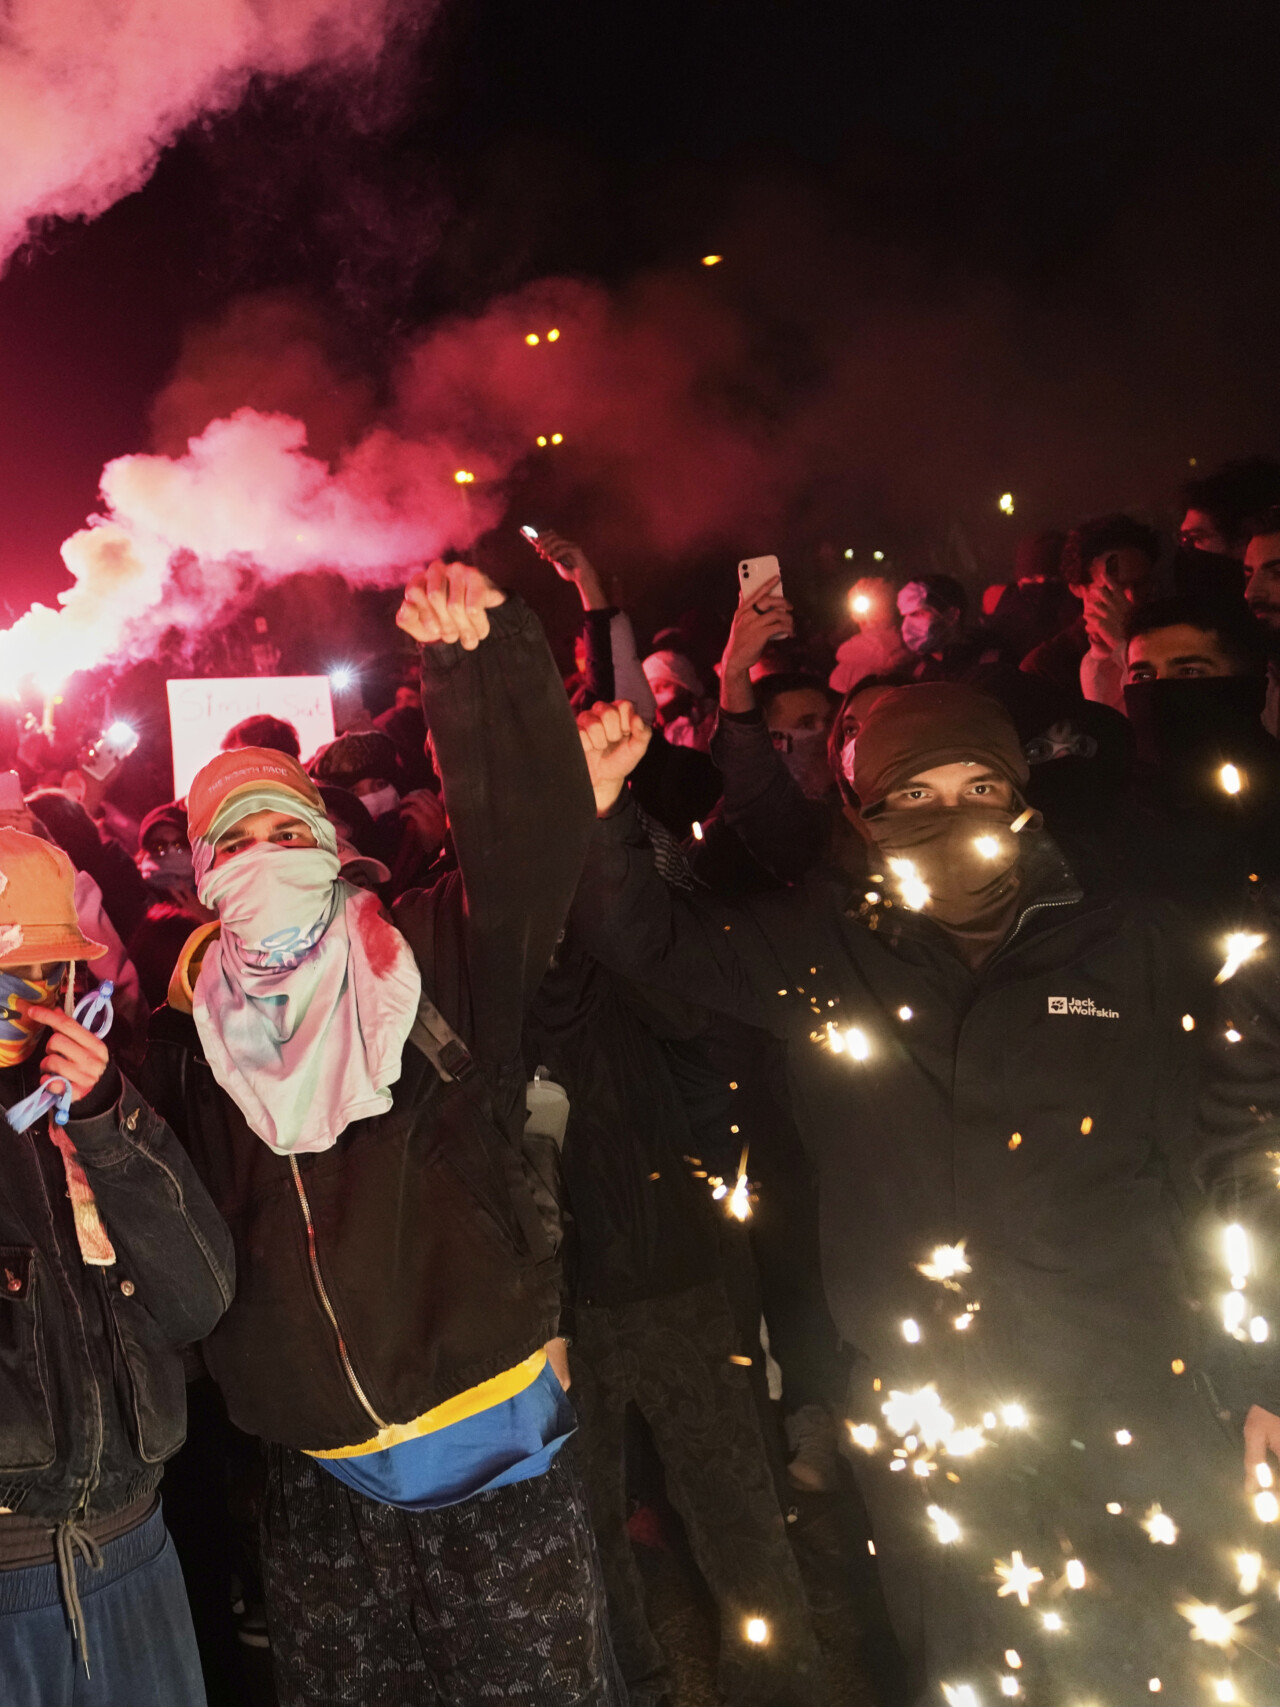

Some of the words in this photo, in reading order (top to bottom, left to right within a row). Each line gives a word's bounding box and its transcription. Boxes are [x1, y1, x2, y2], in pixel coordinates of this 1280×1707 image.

[208, 779, 223, 793] THE
[225, 767, 260, 780] NORTH
[262, 765, 288, 777] FACE
[1069, 997, 1095, 1007] Jack
[1069, 1006, 1119, 1018] Wolfskin
